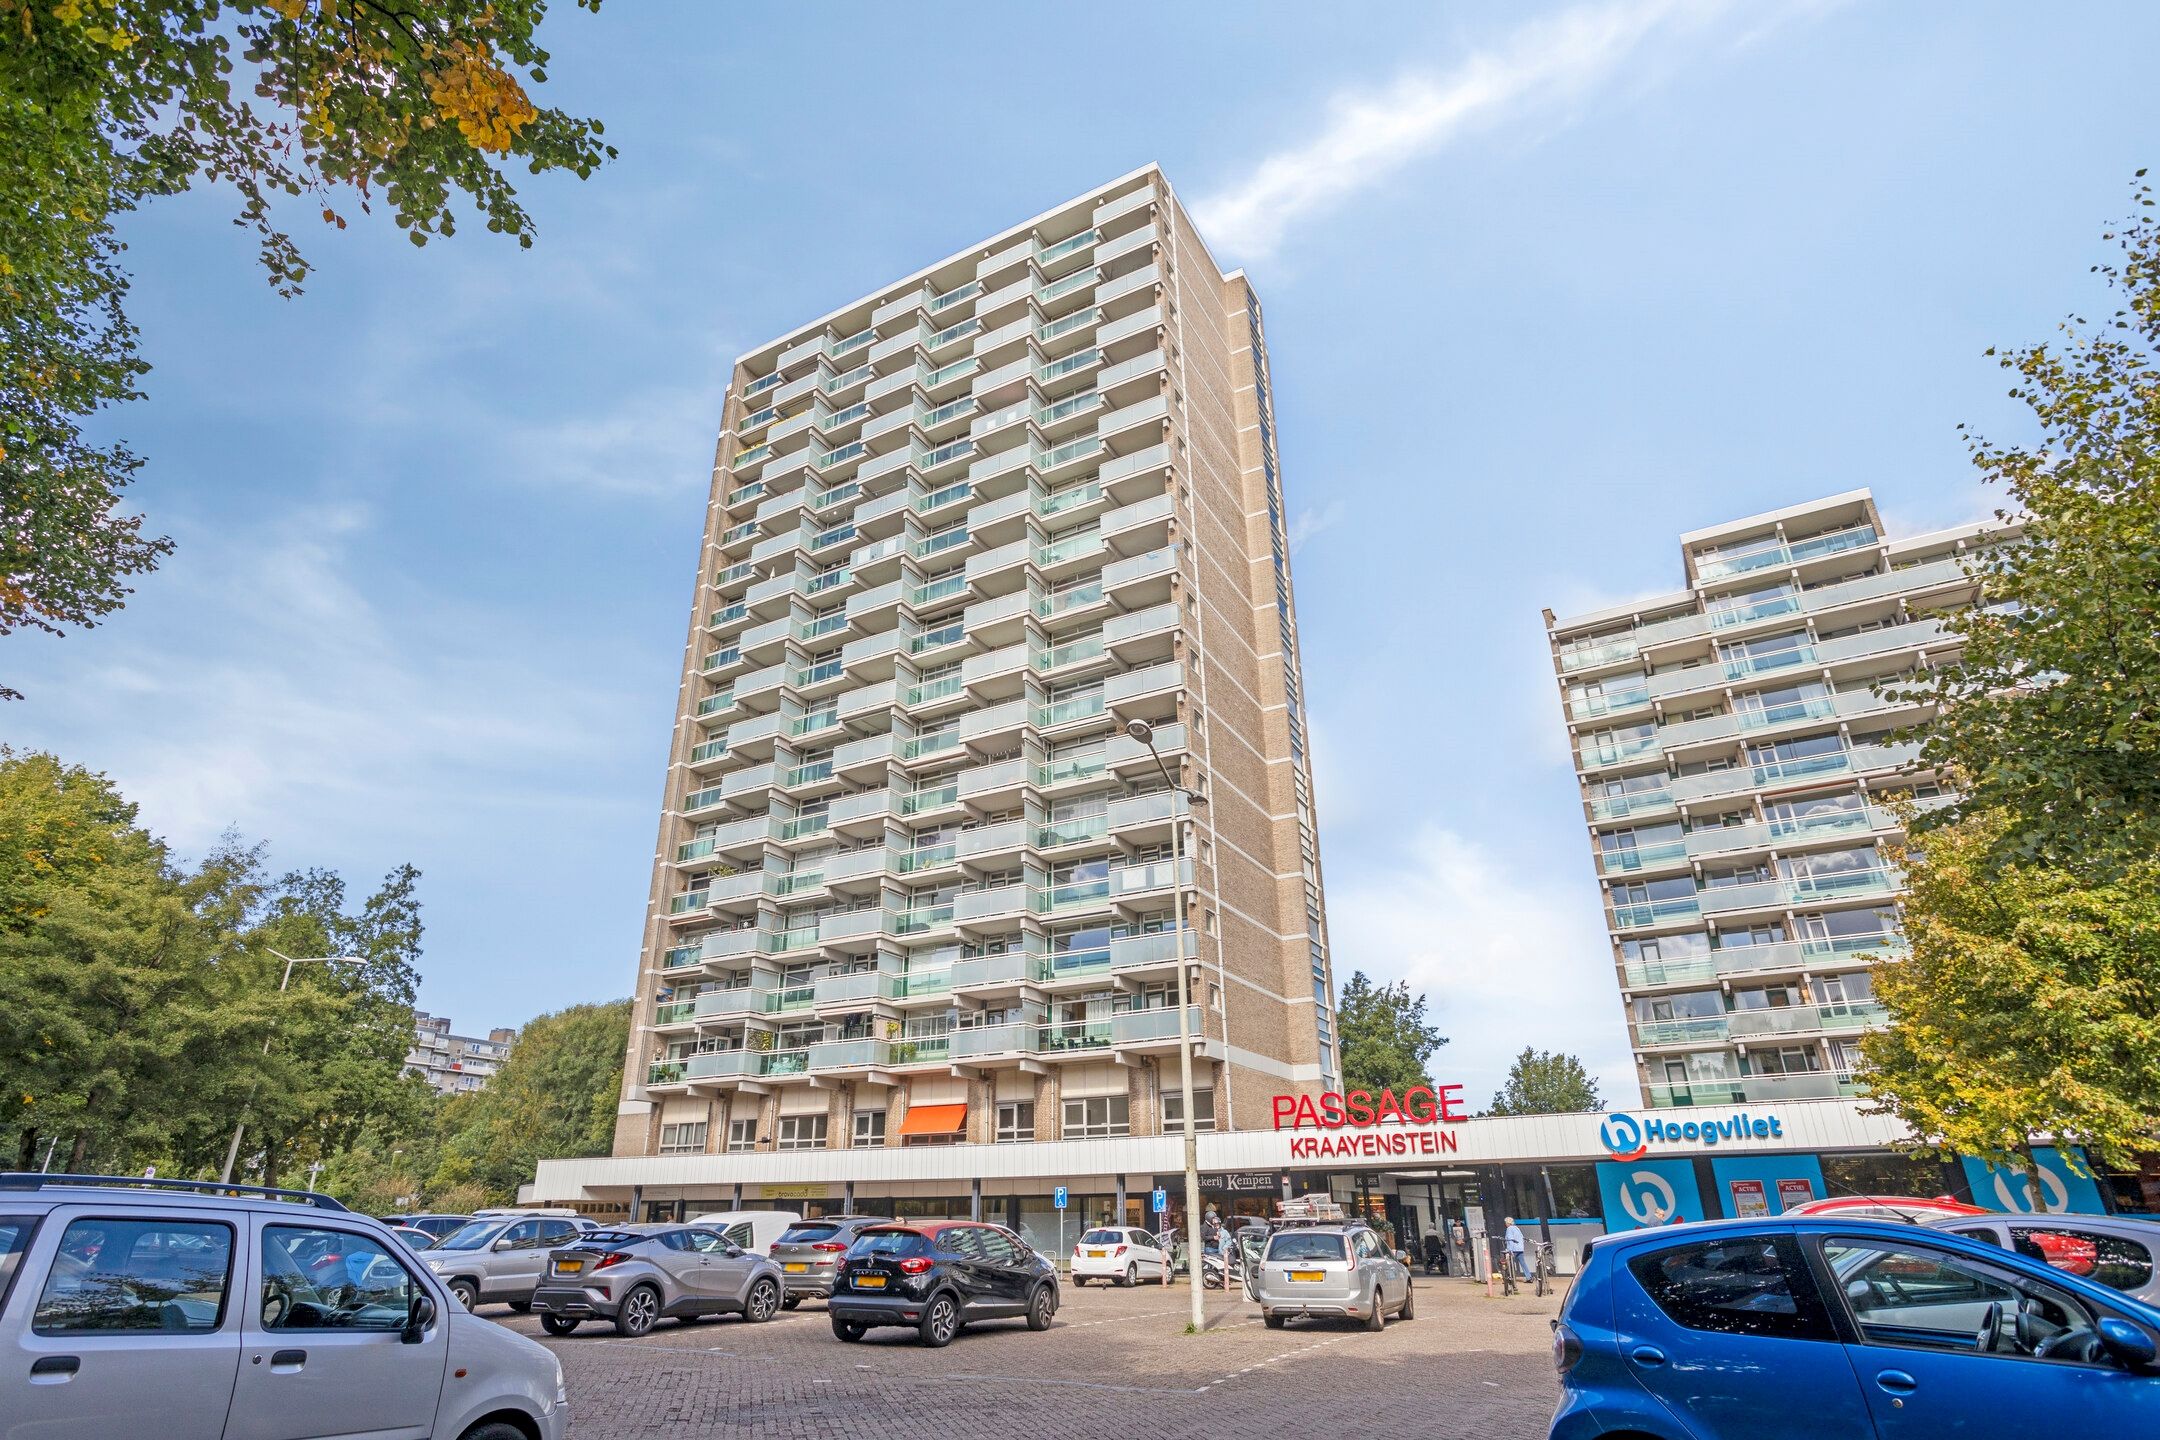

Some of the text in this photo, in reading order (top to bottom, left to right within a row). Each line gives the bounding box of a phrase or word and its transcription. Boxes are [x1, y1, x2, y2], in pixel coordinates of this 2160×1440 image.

[1273, 1084, 1468, 1131] PASSAGE
[1644, 1114, 1783, 1144] Hoogvliet
[1290, 1131, 1457, 1159] KRAAYENSTEIN
[1226, 1174, 1272, 1190] Kempen
